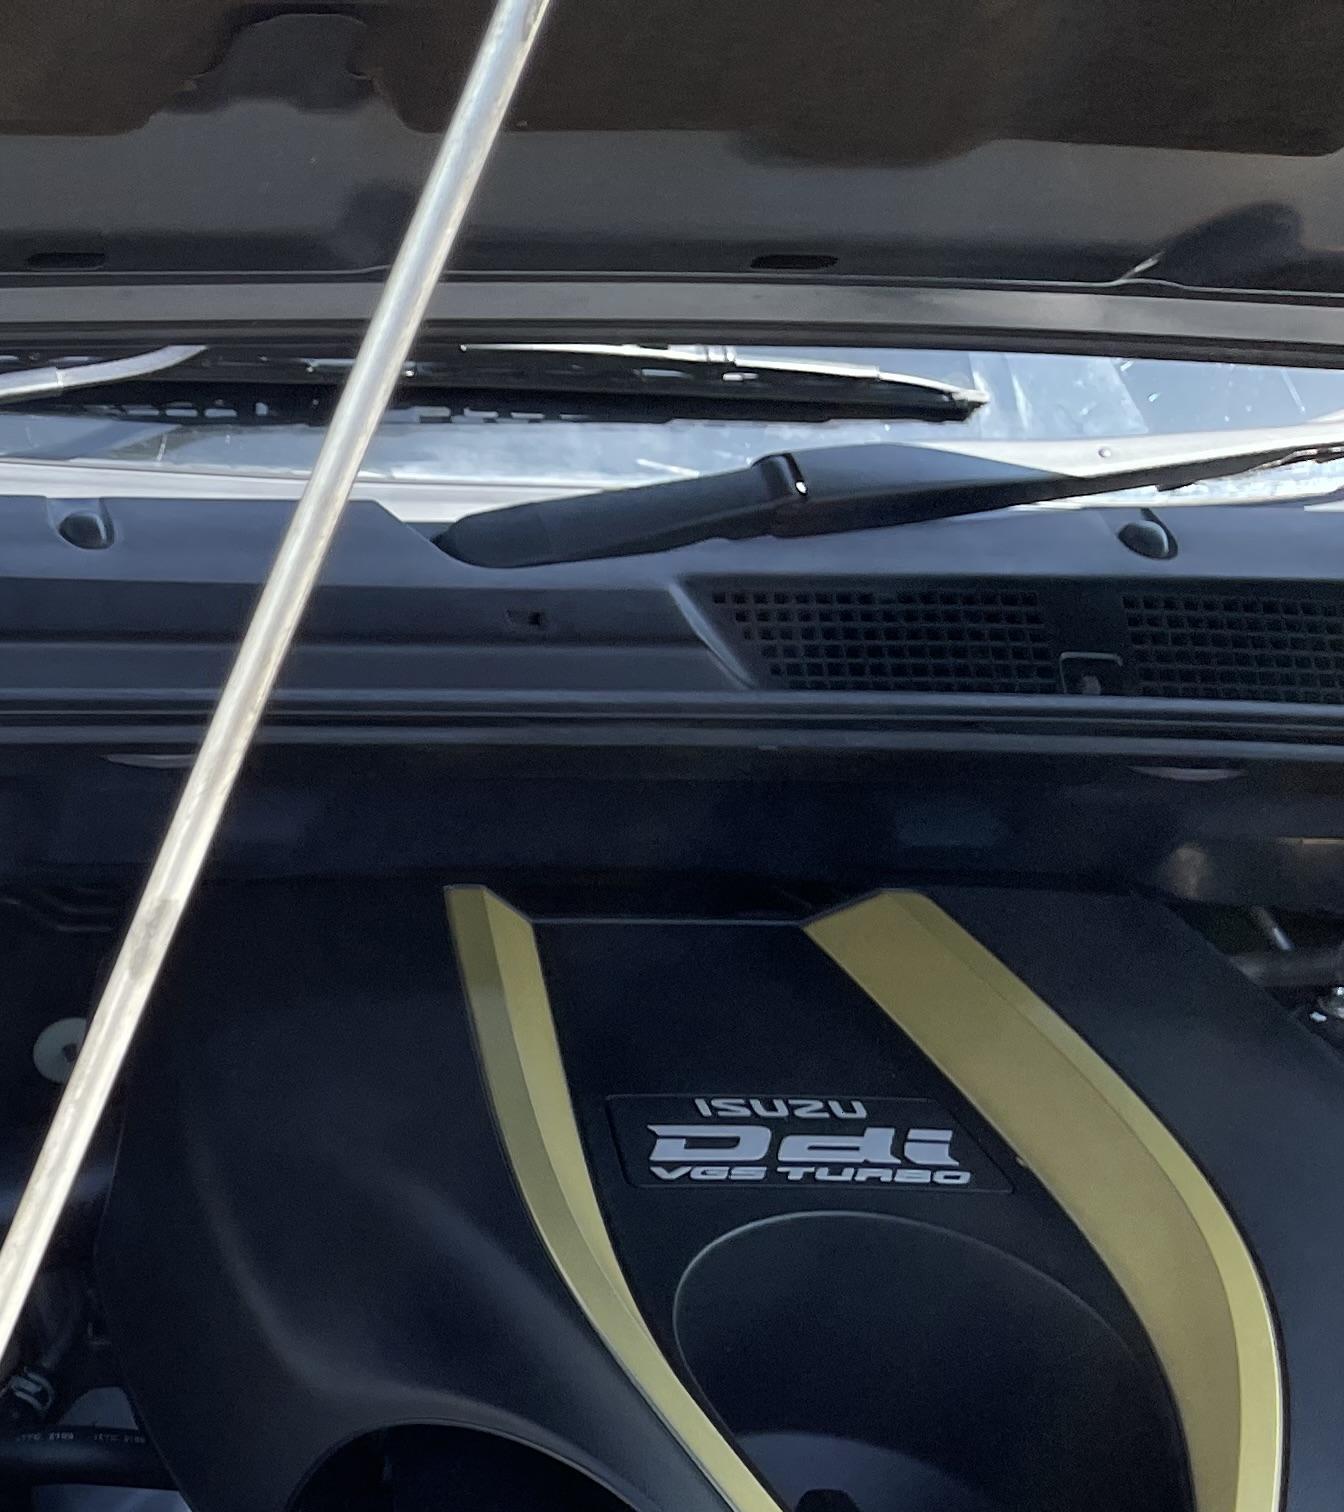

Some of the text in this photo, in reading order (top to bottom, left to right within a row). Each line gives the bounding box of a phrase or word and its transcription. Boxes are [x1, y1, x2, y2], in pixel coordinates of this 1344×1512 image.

[695, 1098, 868, 1120] ISUZU
[649, 1166, 972, 1186] VGS TURBO
